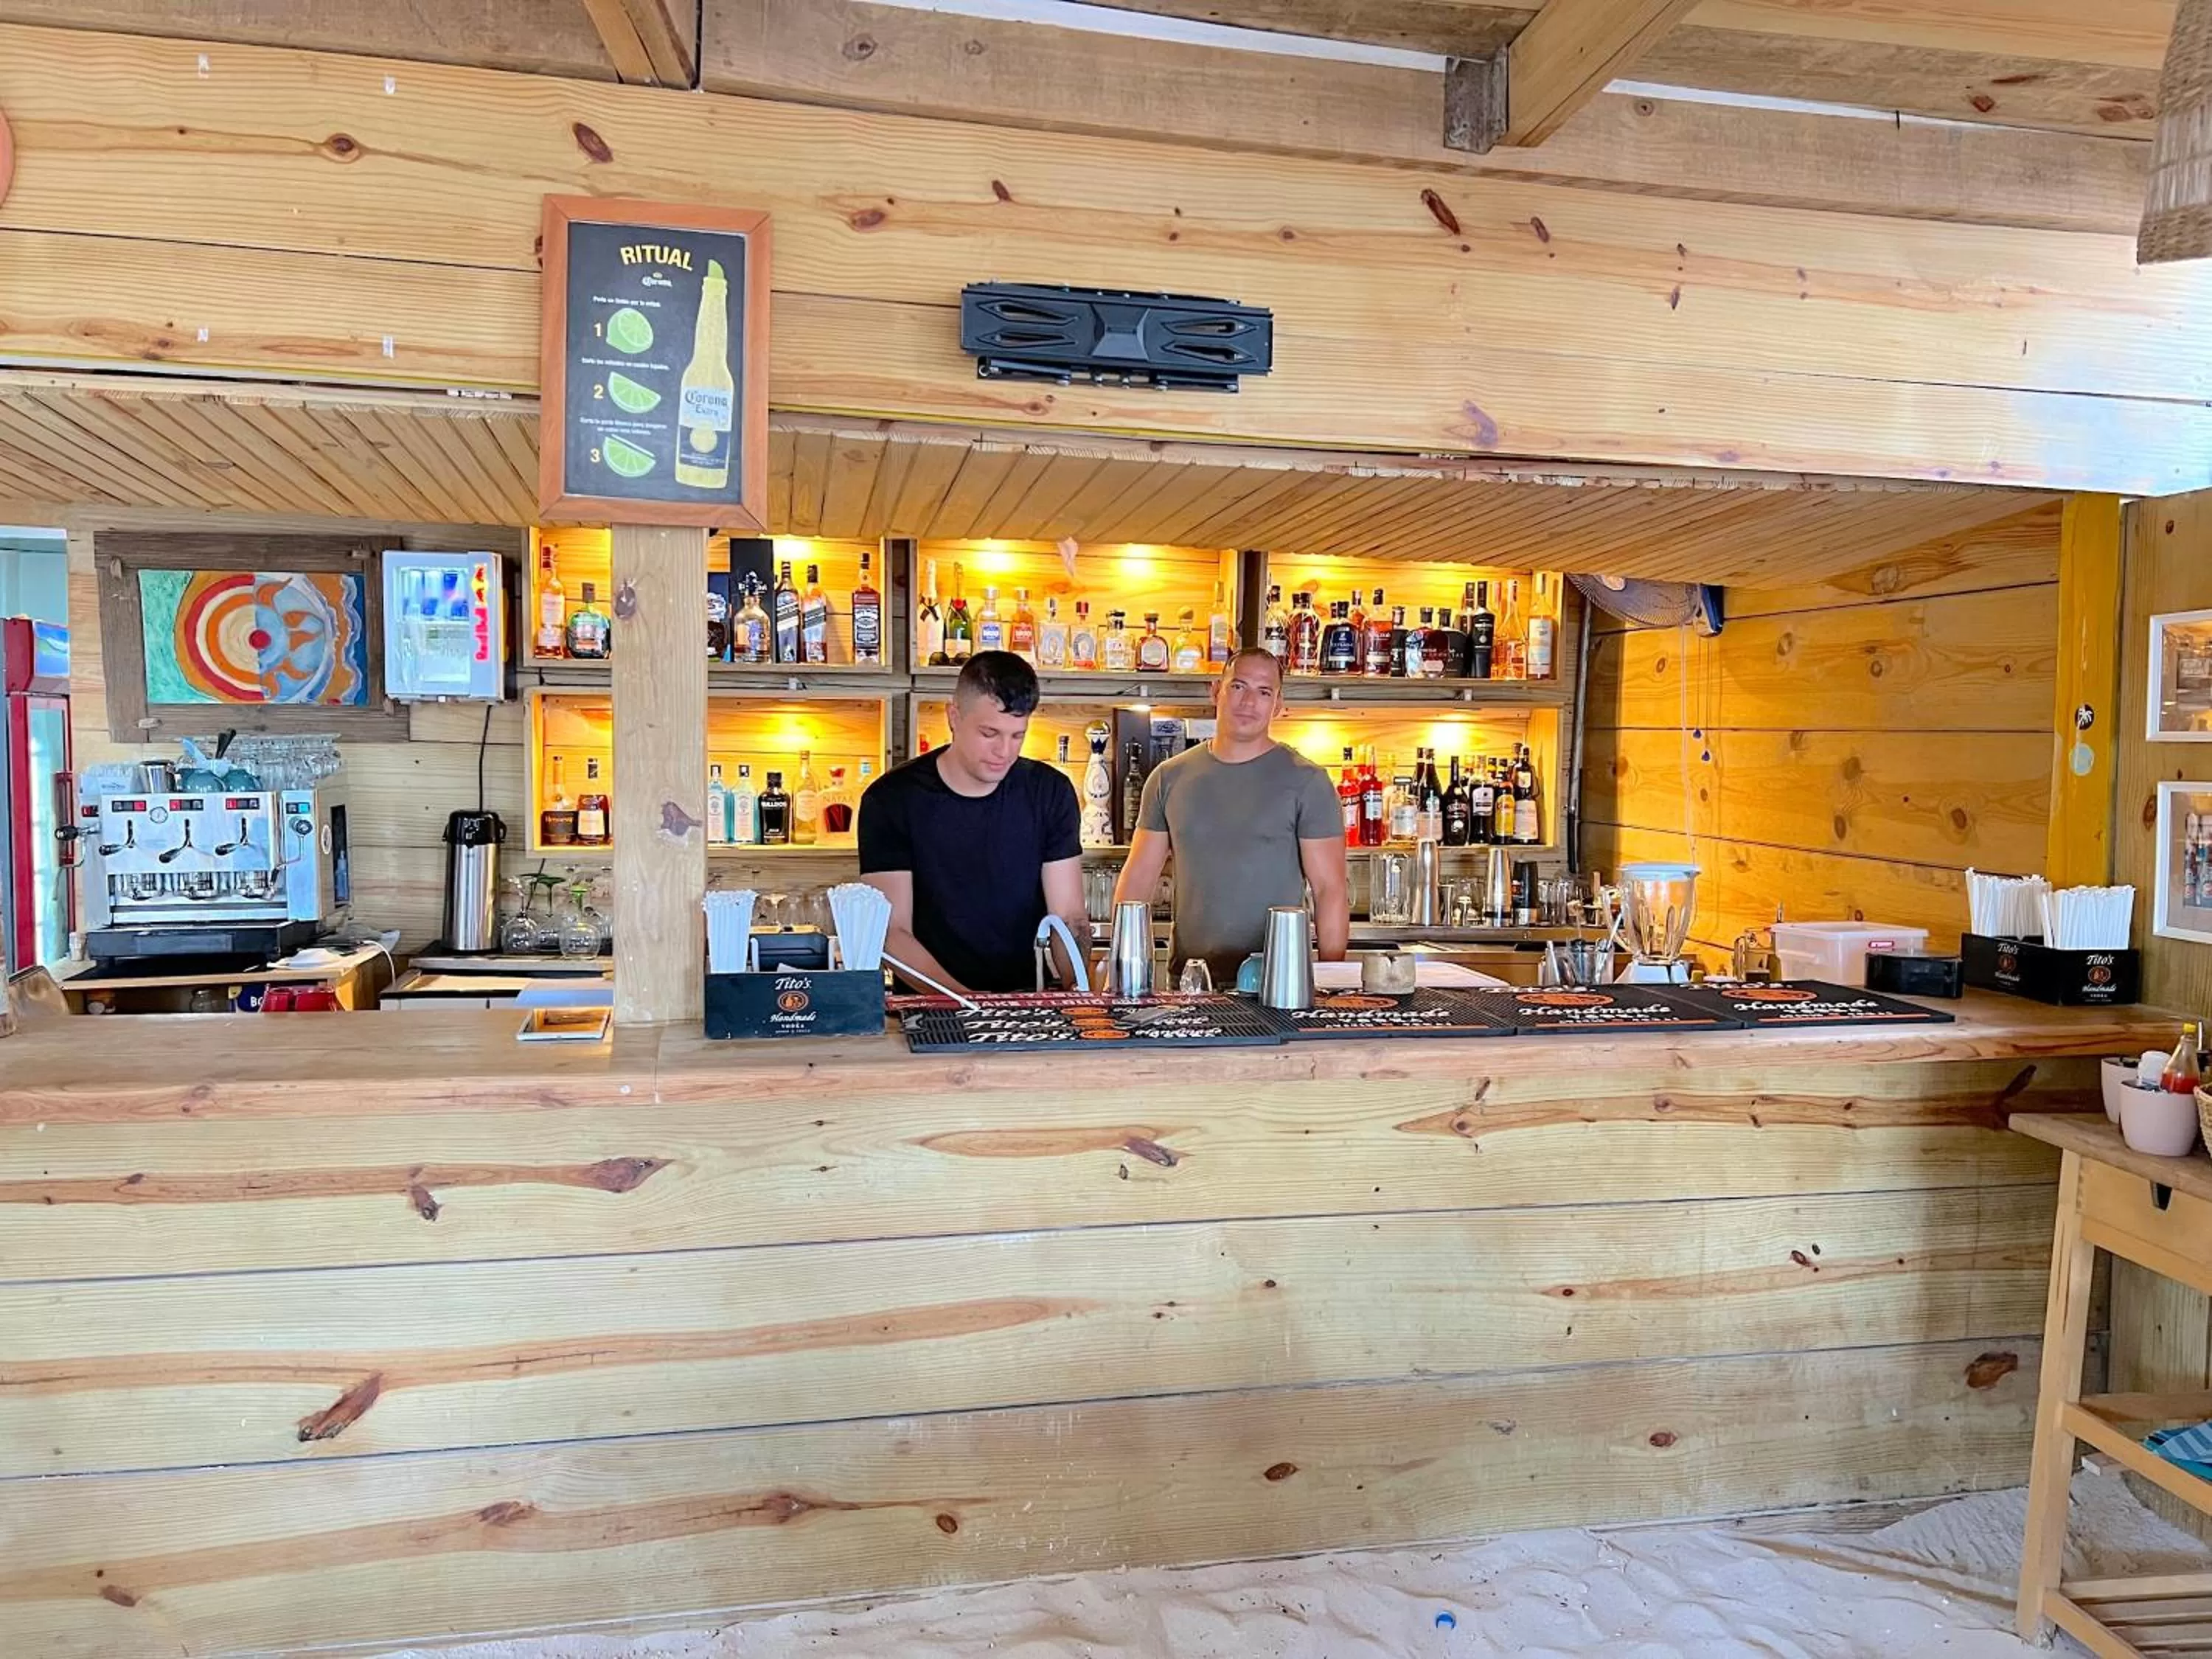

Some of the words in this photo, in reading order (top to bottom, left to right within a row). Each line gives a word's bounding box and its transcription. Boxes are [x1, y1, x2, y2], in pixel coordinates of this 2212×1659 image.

[620, 245, 693, 271] RITUAL
[594, 322, 602, 337] 1
[594, 384, 604, 399] 2
[685, 390, 728, 407] Corona
[591, 448, 600, 463] 3
[1997, 942, 2020, 954] Tito's
[2086, 953, 2115, 965] Tito's
[775, 977, 812, 990] Tito's
[1519, 1004, 1672, 1015] Handmade
[1734, 1000, 1879, 1010] Handmade
[770, 1011, 817, 1022] Handmade
[1291, 1008, 1452, 1019] Handmade
[964, 1018, 1067, 1029] Tito's
[968, 1031, 1076, 1043] Tito's
